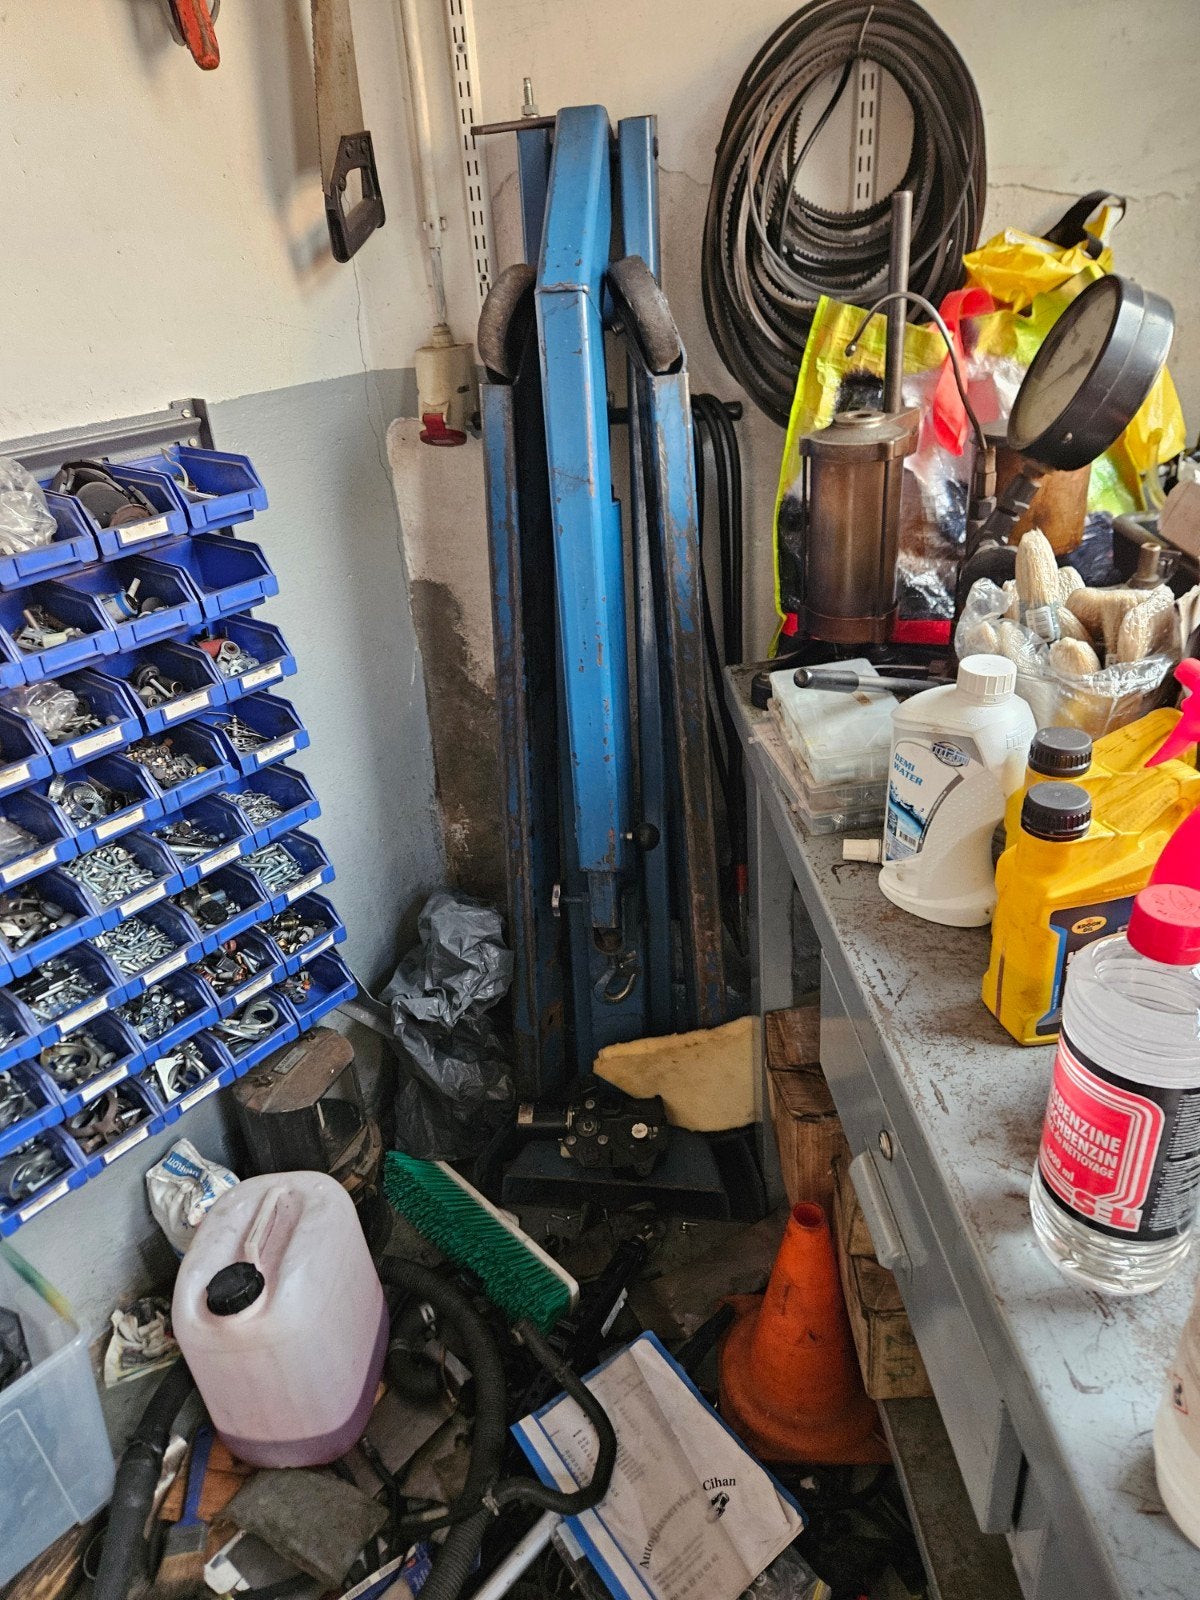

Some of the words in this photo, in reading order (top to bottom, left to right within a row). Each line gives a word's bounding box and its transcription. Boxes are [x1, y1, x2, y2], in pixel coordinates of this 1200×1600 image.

[894, 752, 915, 772] DEMI
[893, 761, 923, 786] WATER
[1063, 1141, 1115, 1179] NETTOYAGE
[1062, 1169, 1075, 1182] ml
[702, 1476, 736, 1491] Cihan
